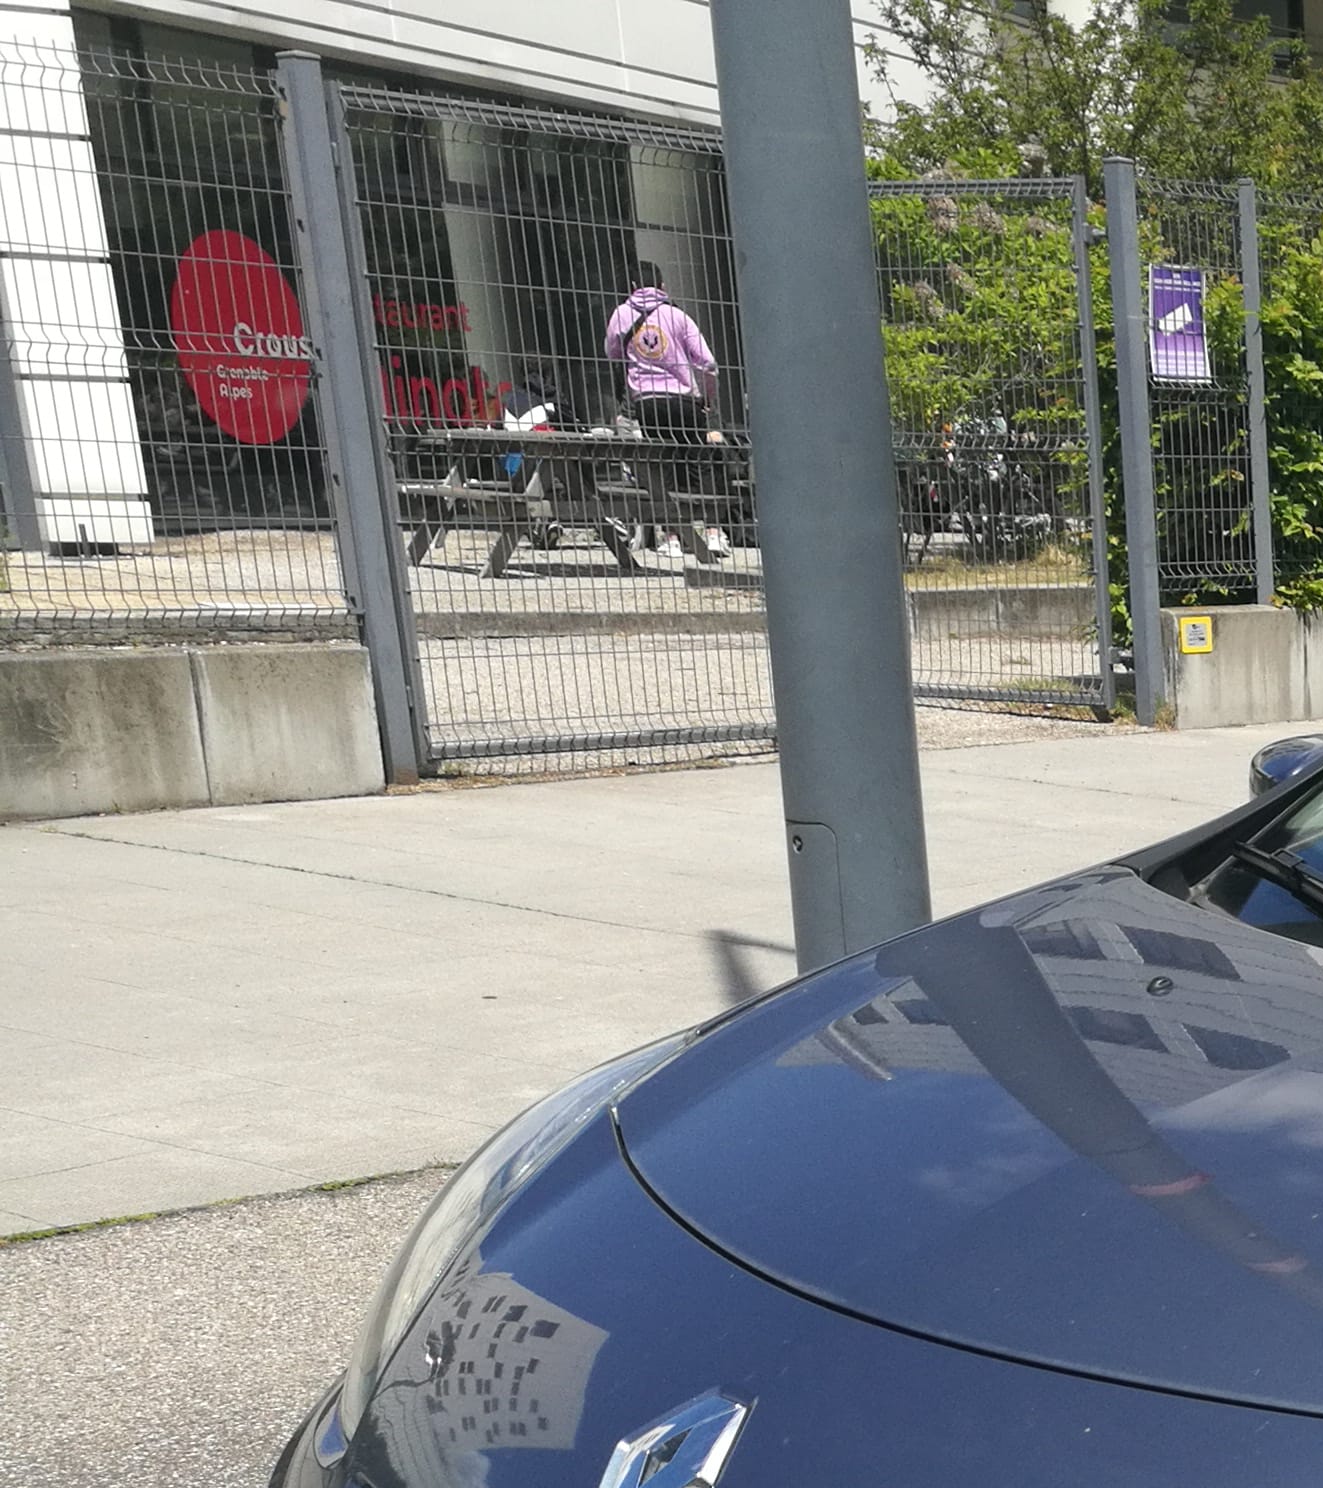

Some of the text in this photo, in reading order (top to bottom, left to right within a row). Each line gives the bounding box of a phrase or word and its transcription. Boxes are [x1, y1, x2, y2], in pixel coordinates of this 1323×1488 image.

[373, 293, 472, 332] taurant
[233, 322, 315, 359] Crous
[216, 364, 269, 381] Grenoble
[219, 383, 253, 401] Alpes
